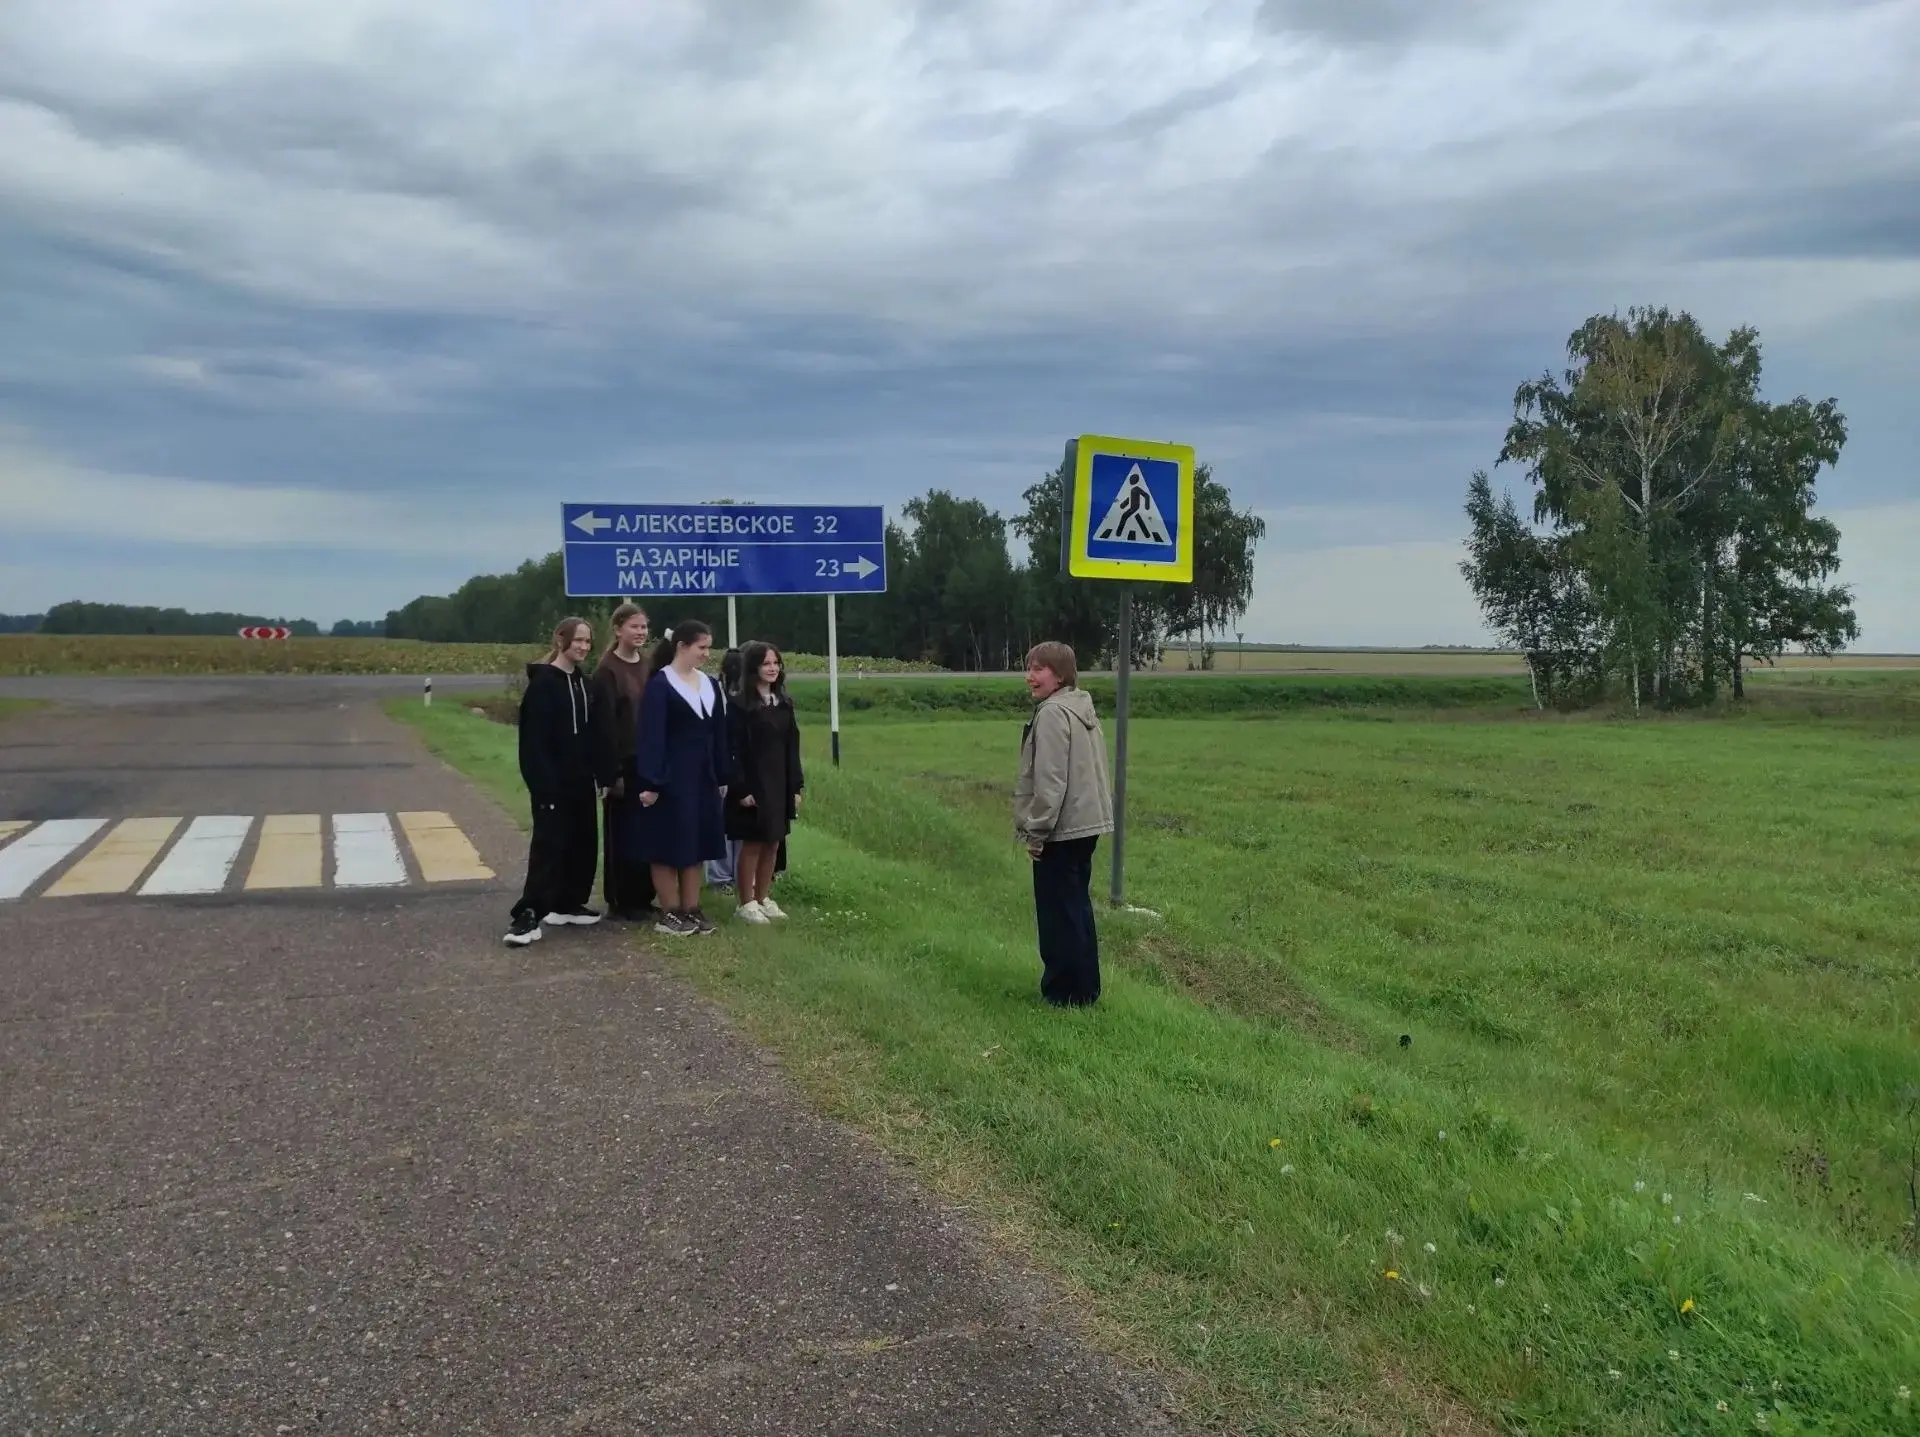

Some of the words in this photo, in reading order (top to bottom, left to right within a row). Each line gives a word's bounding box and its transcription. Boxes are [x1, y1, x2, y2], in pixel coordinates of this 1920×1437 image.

[615, 515, 794, 534] АЛЕКСЕЕВСКОЕ
[813, 516, 838, 534] 32
[616, 548, 740, 567] БАЗАРНЫЕ
[815, 559, 840, 577] 23
[618, 571, 716, 589] МАТАКИ
